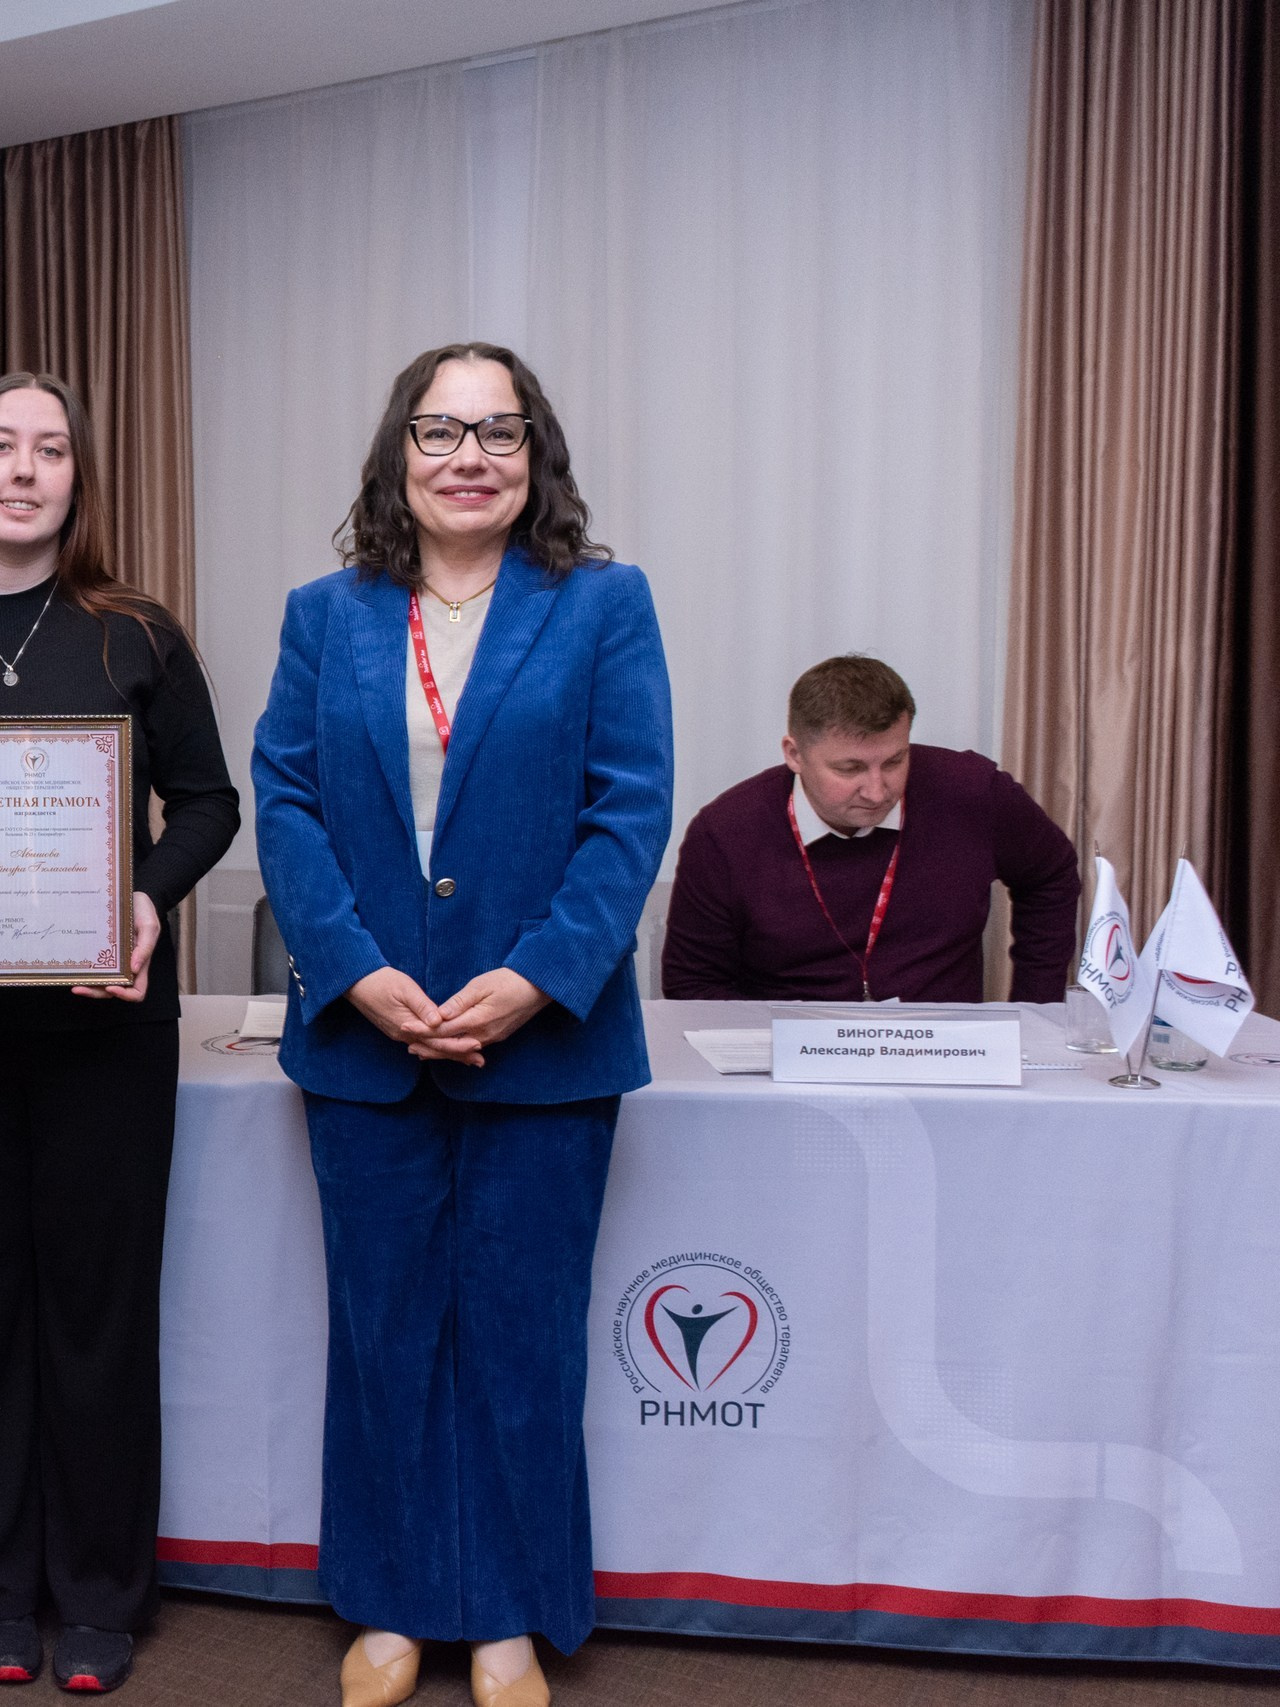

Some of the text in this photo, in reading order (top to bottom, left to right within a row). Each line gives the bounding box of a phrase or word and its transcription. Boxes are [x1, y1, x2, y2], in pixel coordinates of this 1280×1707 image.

[42, 795, 101, 808] ГРАМОТА
[836, 1028, 935, 1040] ВИНОГРАДОВ
[799, 1045, 987, 1058] Александр Владимирович
[612, 1252, 792, 1395] Российское научное медицинское общество терапевтов
[640, 1400, 765, 1429] РНМОТ
